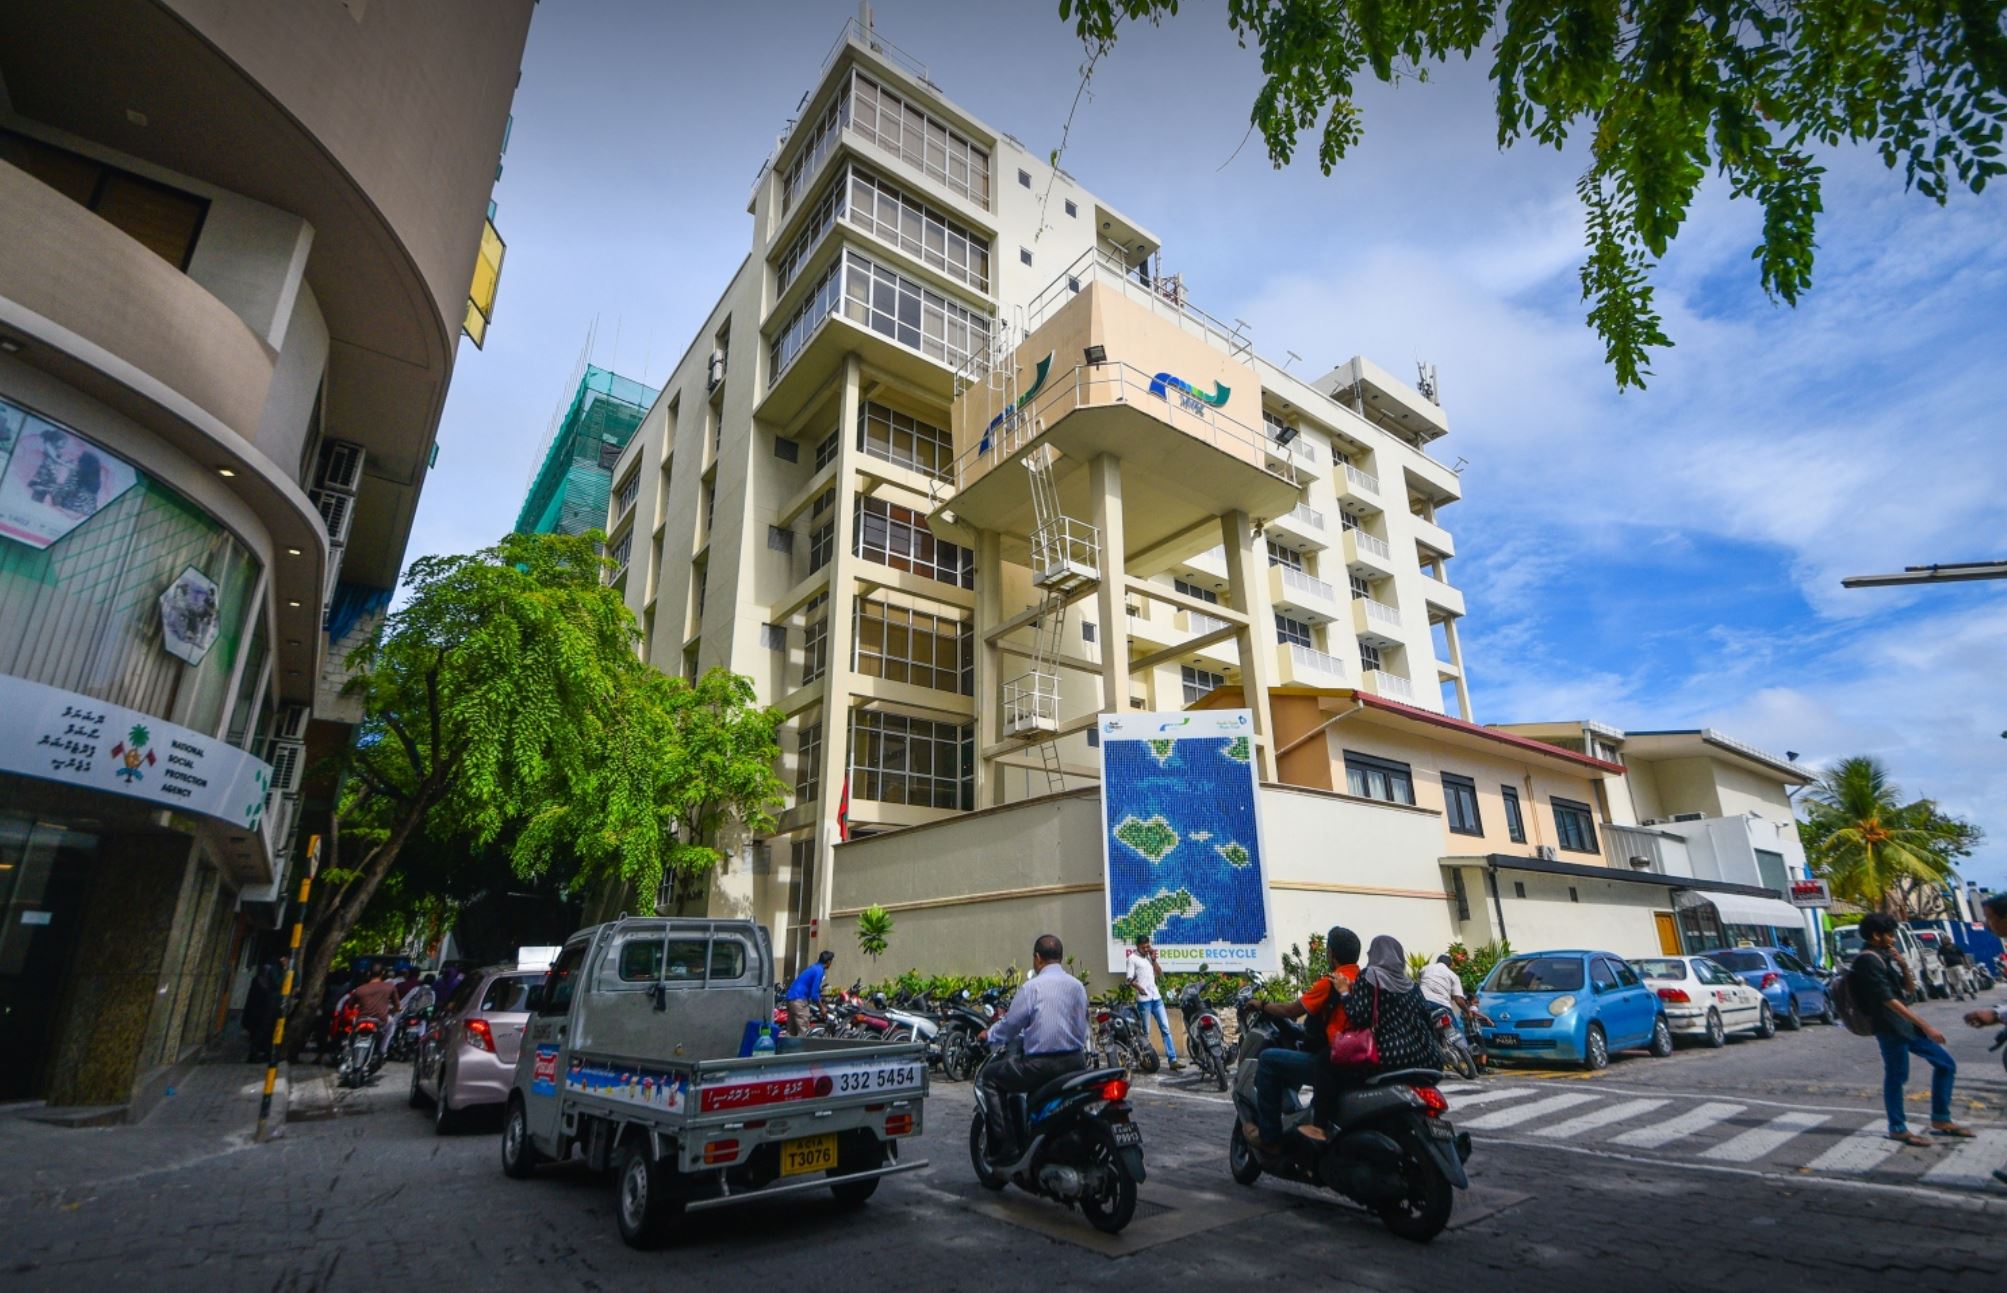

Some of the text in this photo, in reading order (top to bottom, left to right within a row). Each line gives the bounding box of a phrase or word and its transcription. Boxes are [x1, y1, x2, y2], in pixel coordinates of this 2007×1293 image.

[171, 740, 204, 758] NATIONAL
[168, 754, 194, 769] SOCIAL
[165, 769, 208, 788] PROTECTION
[161, 784, 192, 797] AGENCY
[1160, 948, 1204, 959] REDUCE
[1205, 948, 1257, 959] RECYCLE
[840, 1066, 915, 1091] 332 5454
[788, 1148, 831, 1168] T3076
